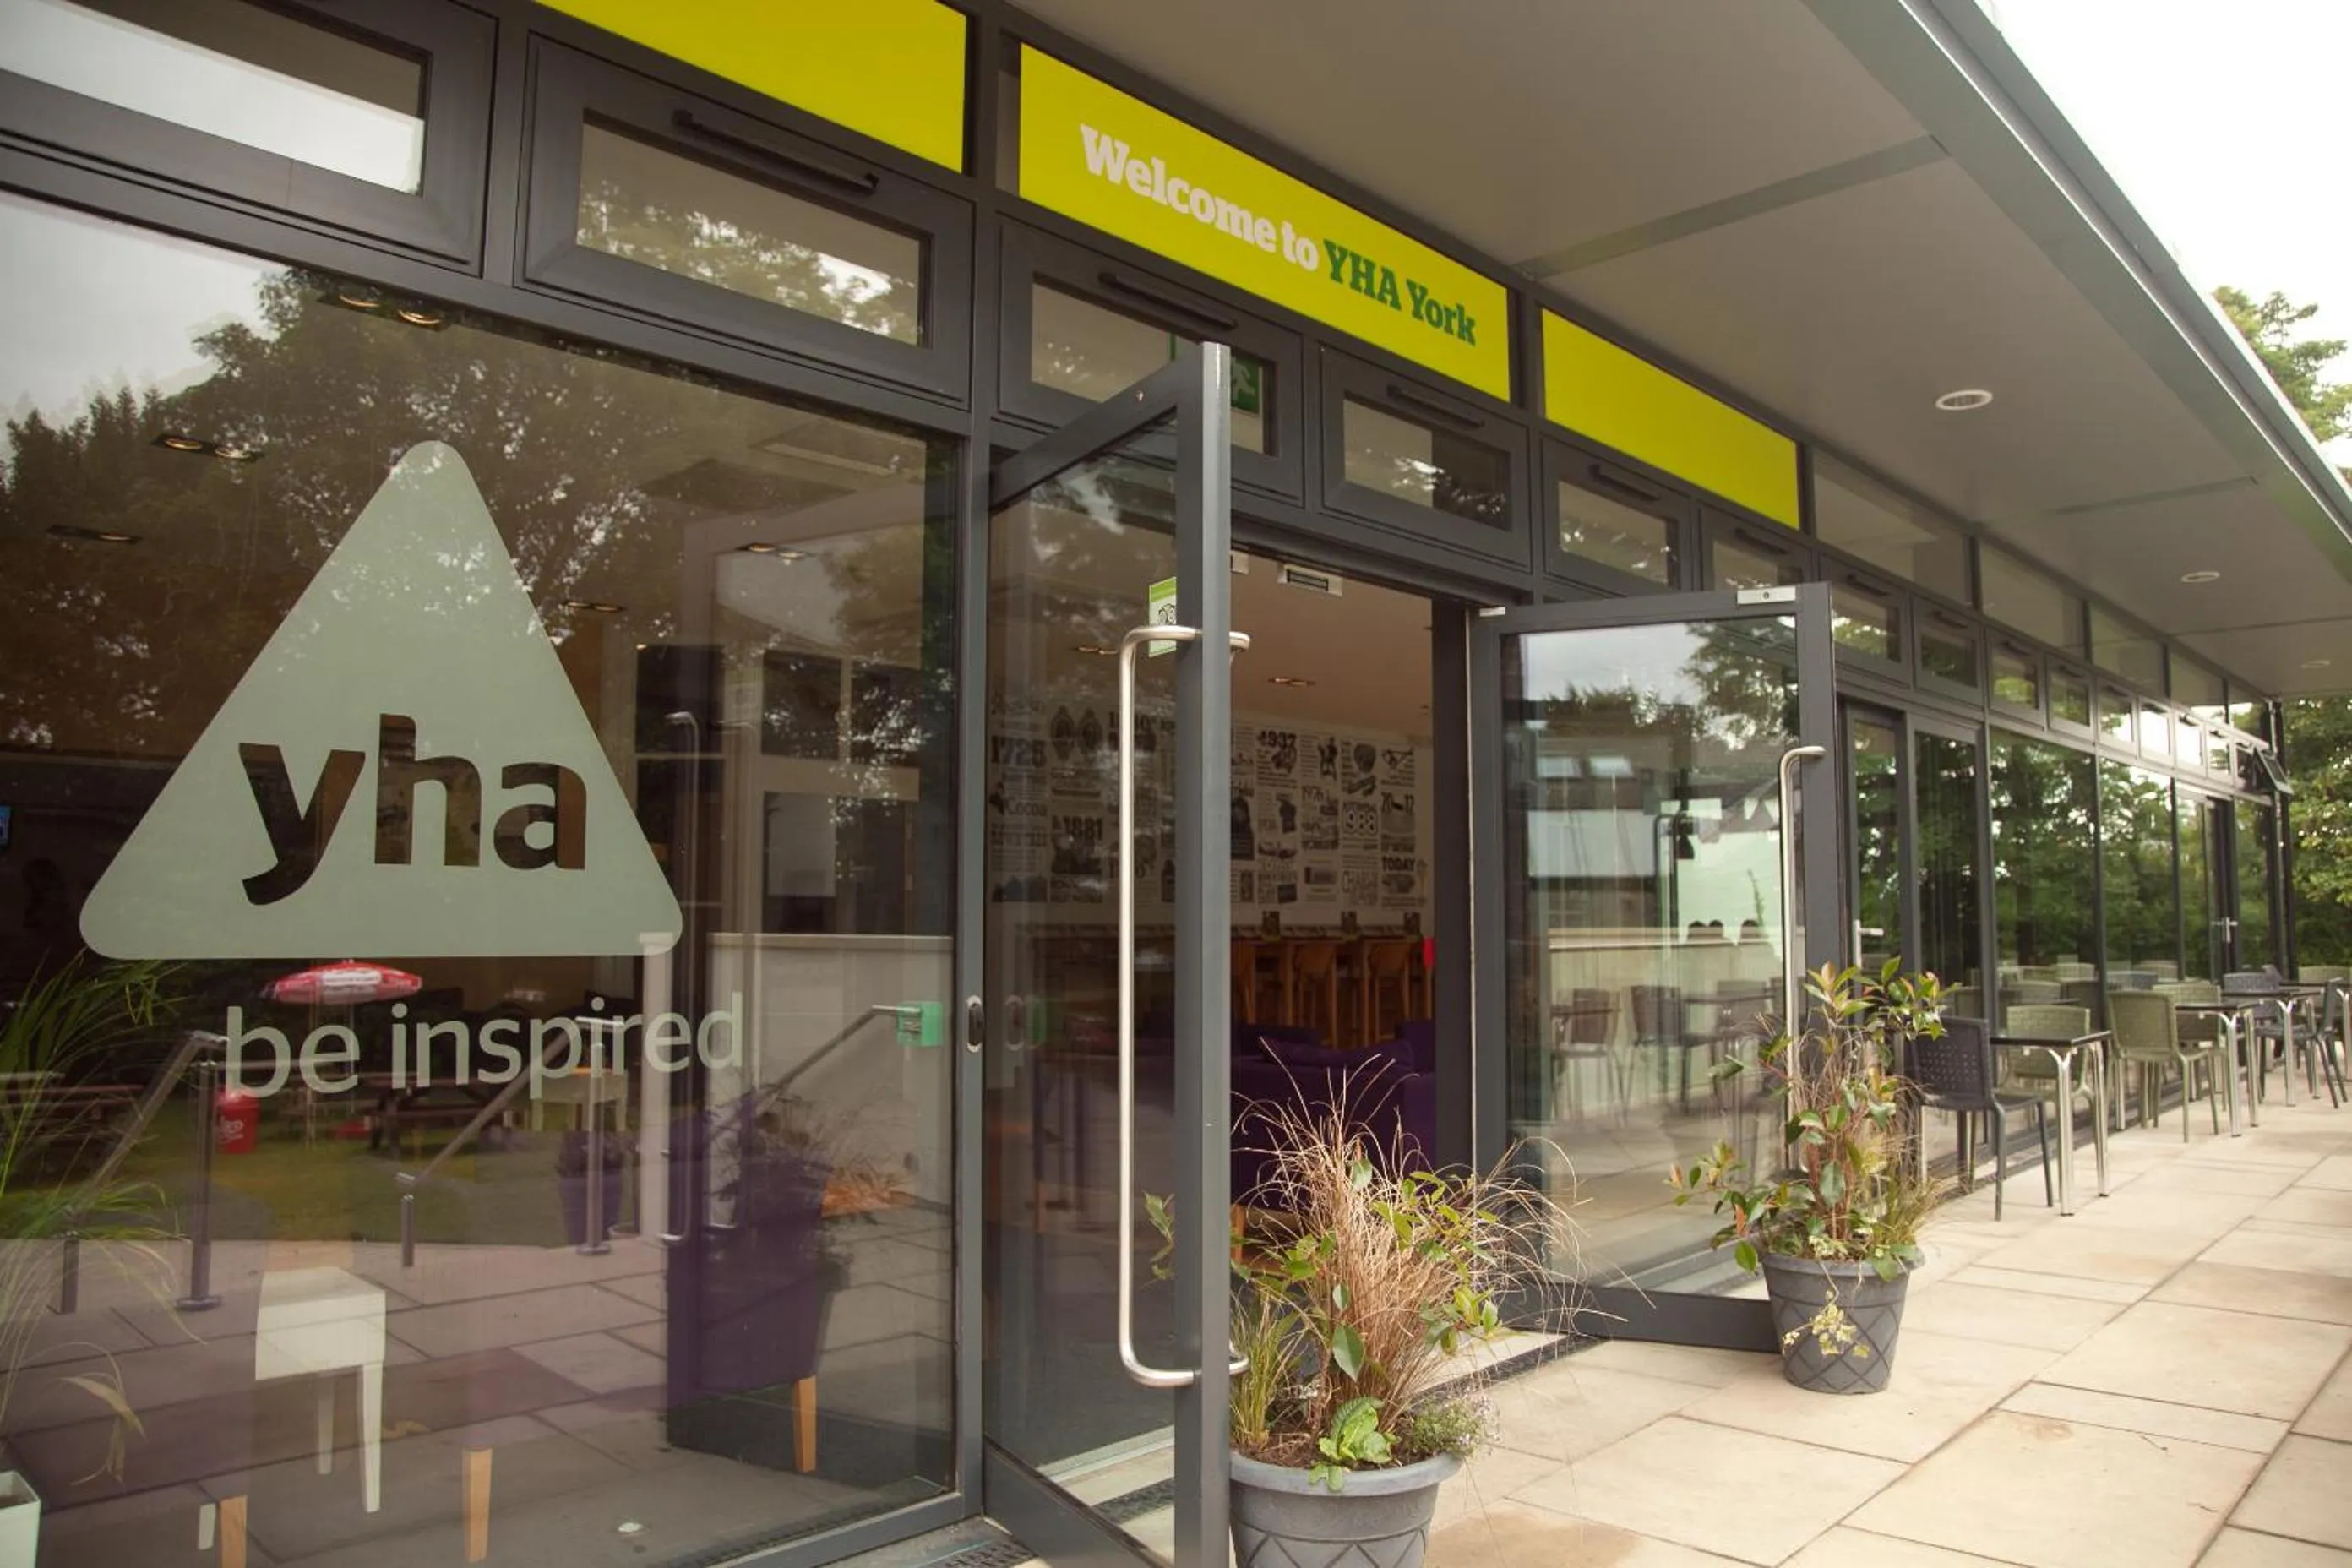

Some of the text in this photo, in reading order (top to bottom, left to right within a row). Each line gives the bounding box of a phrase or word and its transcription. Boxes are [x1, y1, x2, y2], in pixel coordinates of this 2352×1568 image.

[1080, 123, 1477, 346] Welcome to YHA York
[238, 713, 587, 906] yha
[1382, 855, 1415, 873] TODAY
[225, 991, 743, 1101] be inspired
